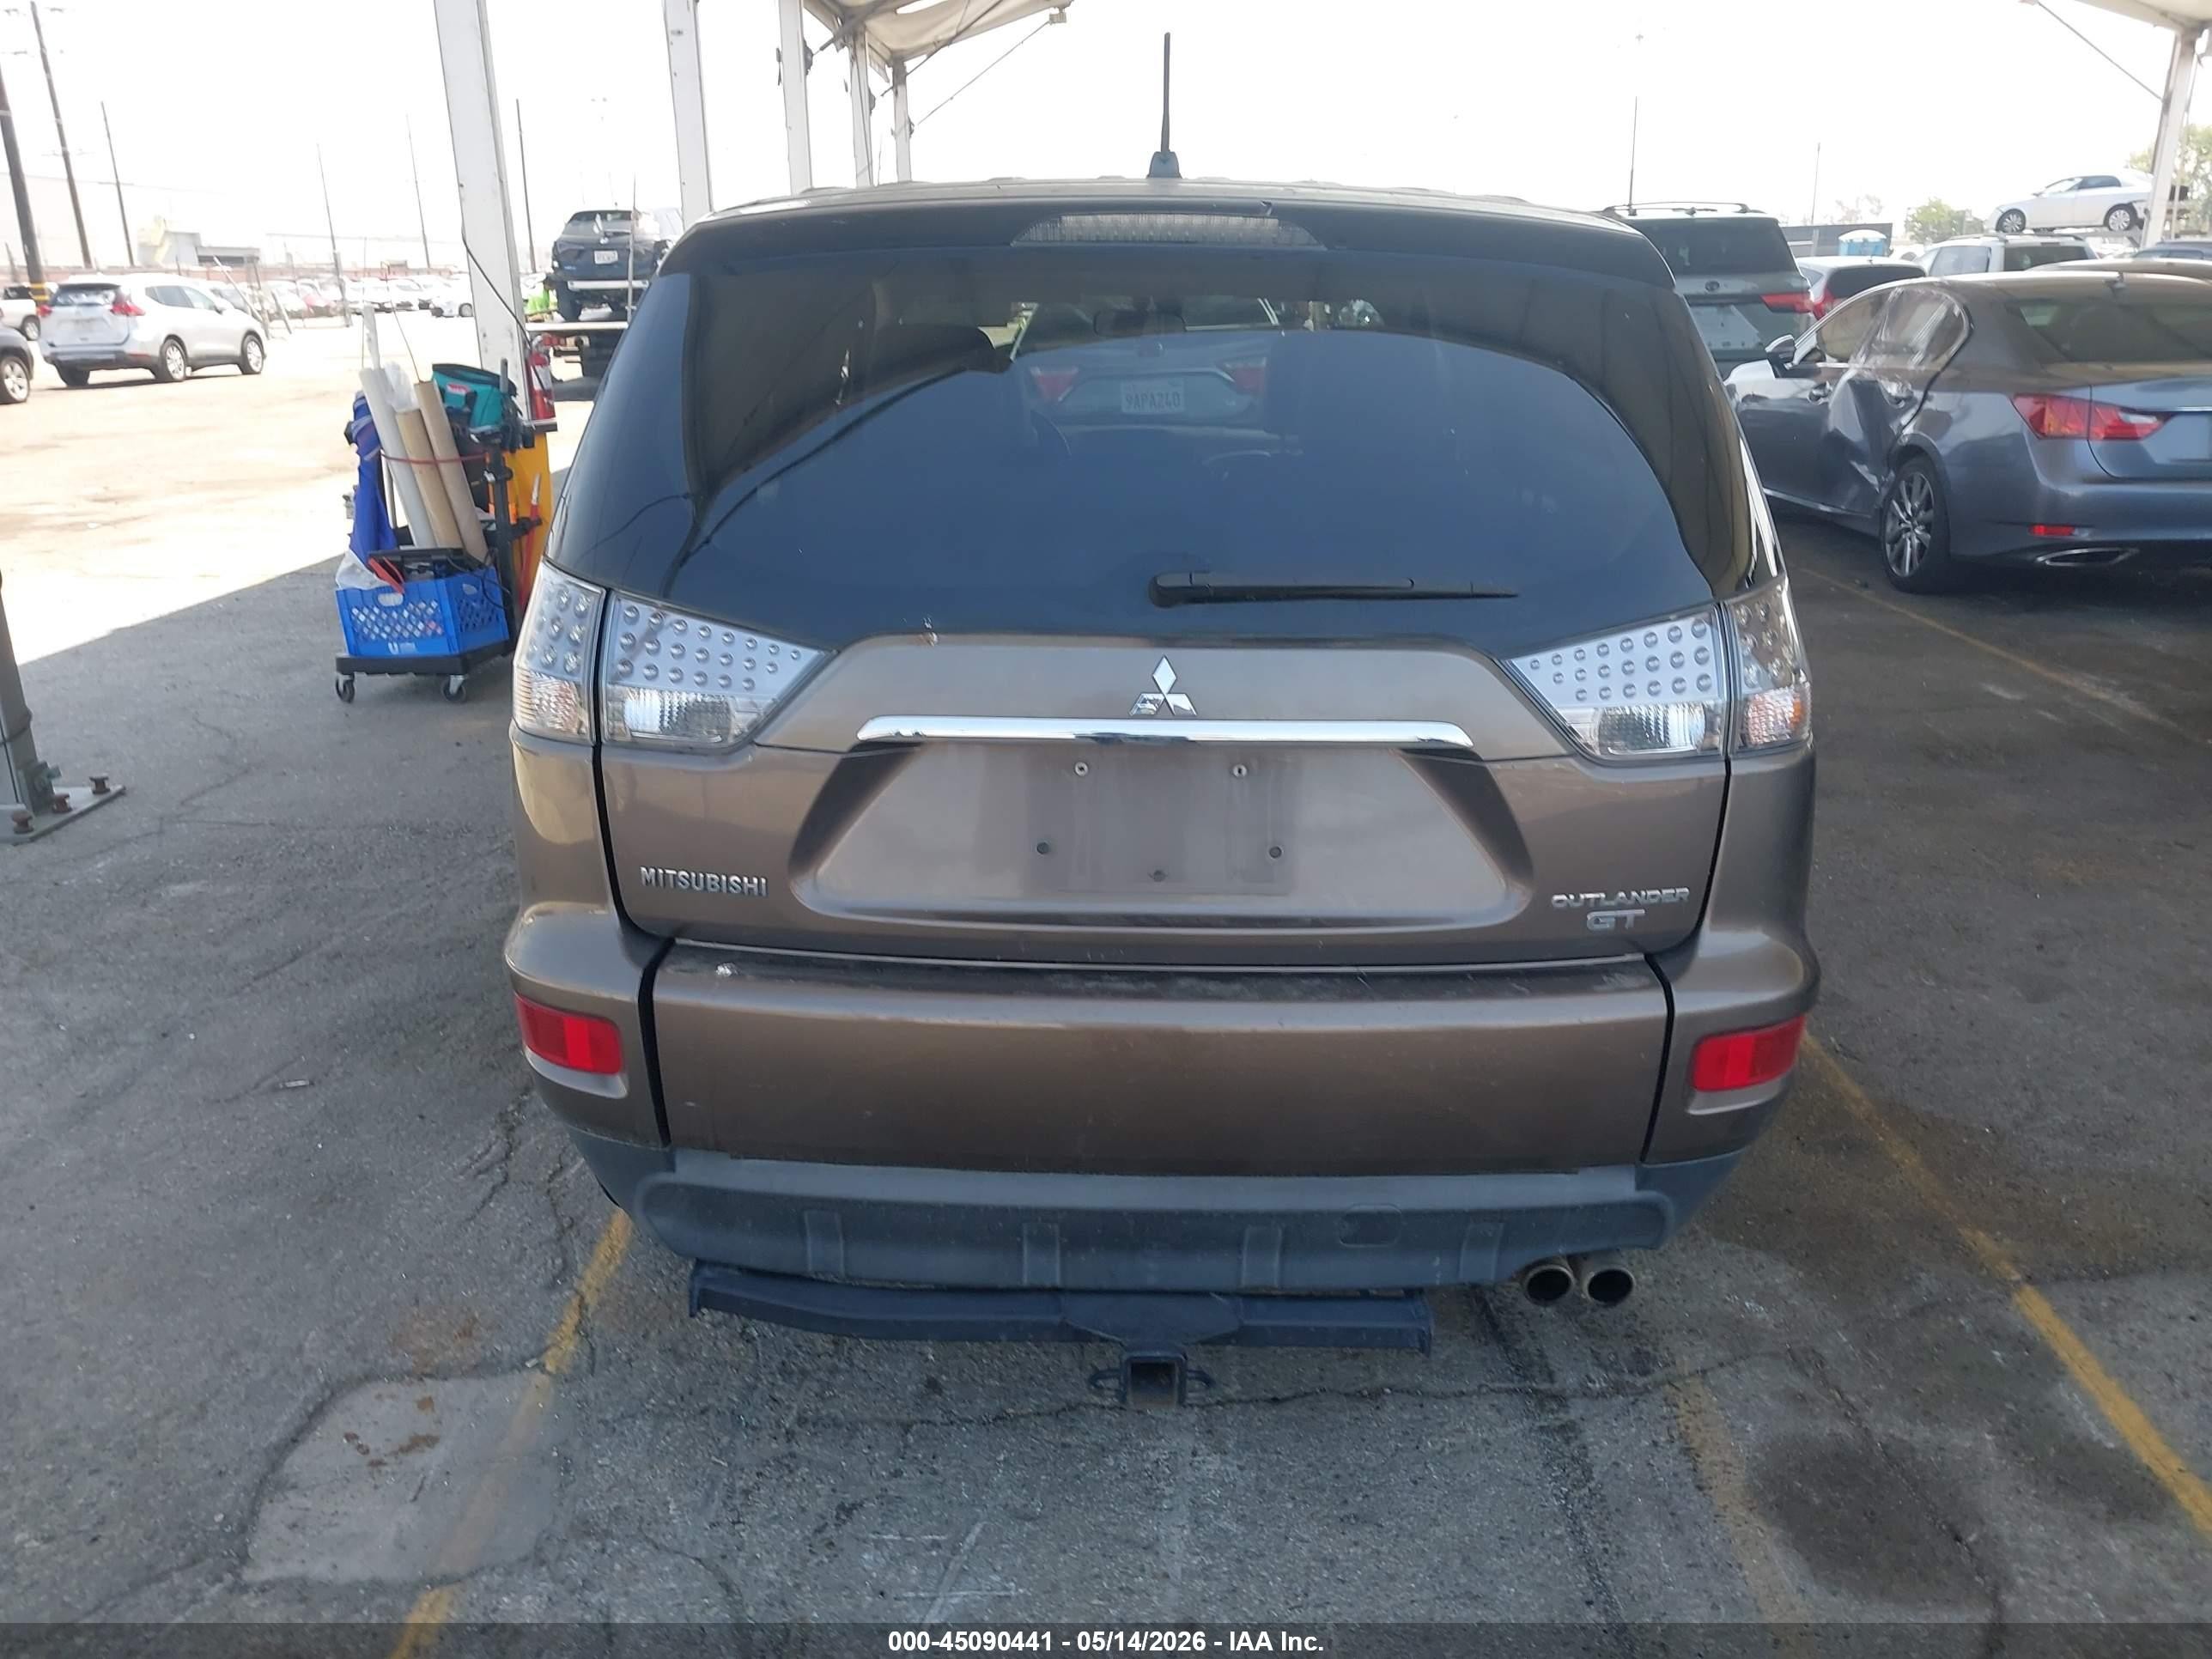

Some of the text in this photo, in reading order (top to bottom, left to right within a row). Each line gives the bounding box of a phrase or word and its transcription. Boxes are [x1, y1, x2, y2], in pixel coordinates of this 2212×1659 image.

[640, 866, 767, 897] MITSUBISHI
[1551, 887, 1690, 908] OUTLANDER
[1587, 908, 1645, 931] GT
